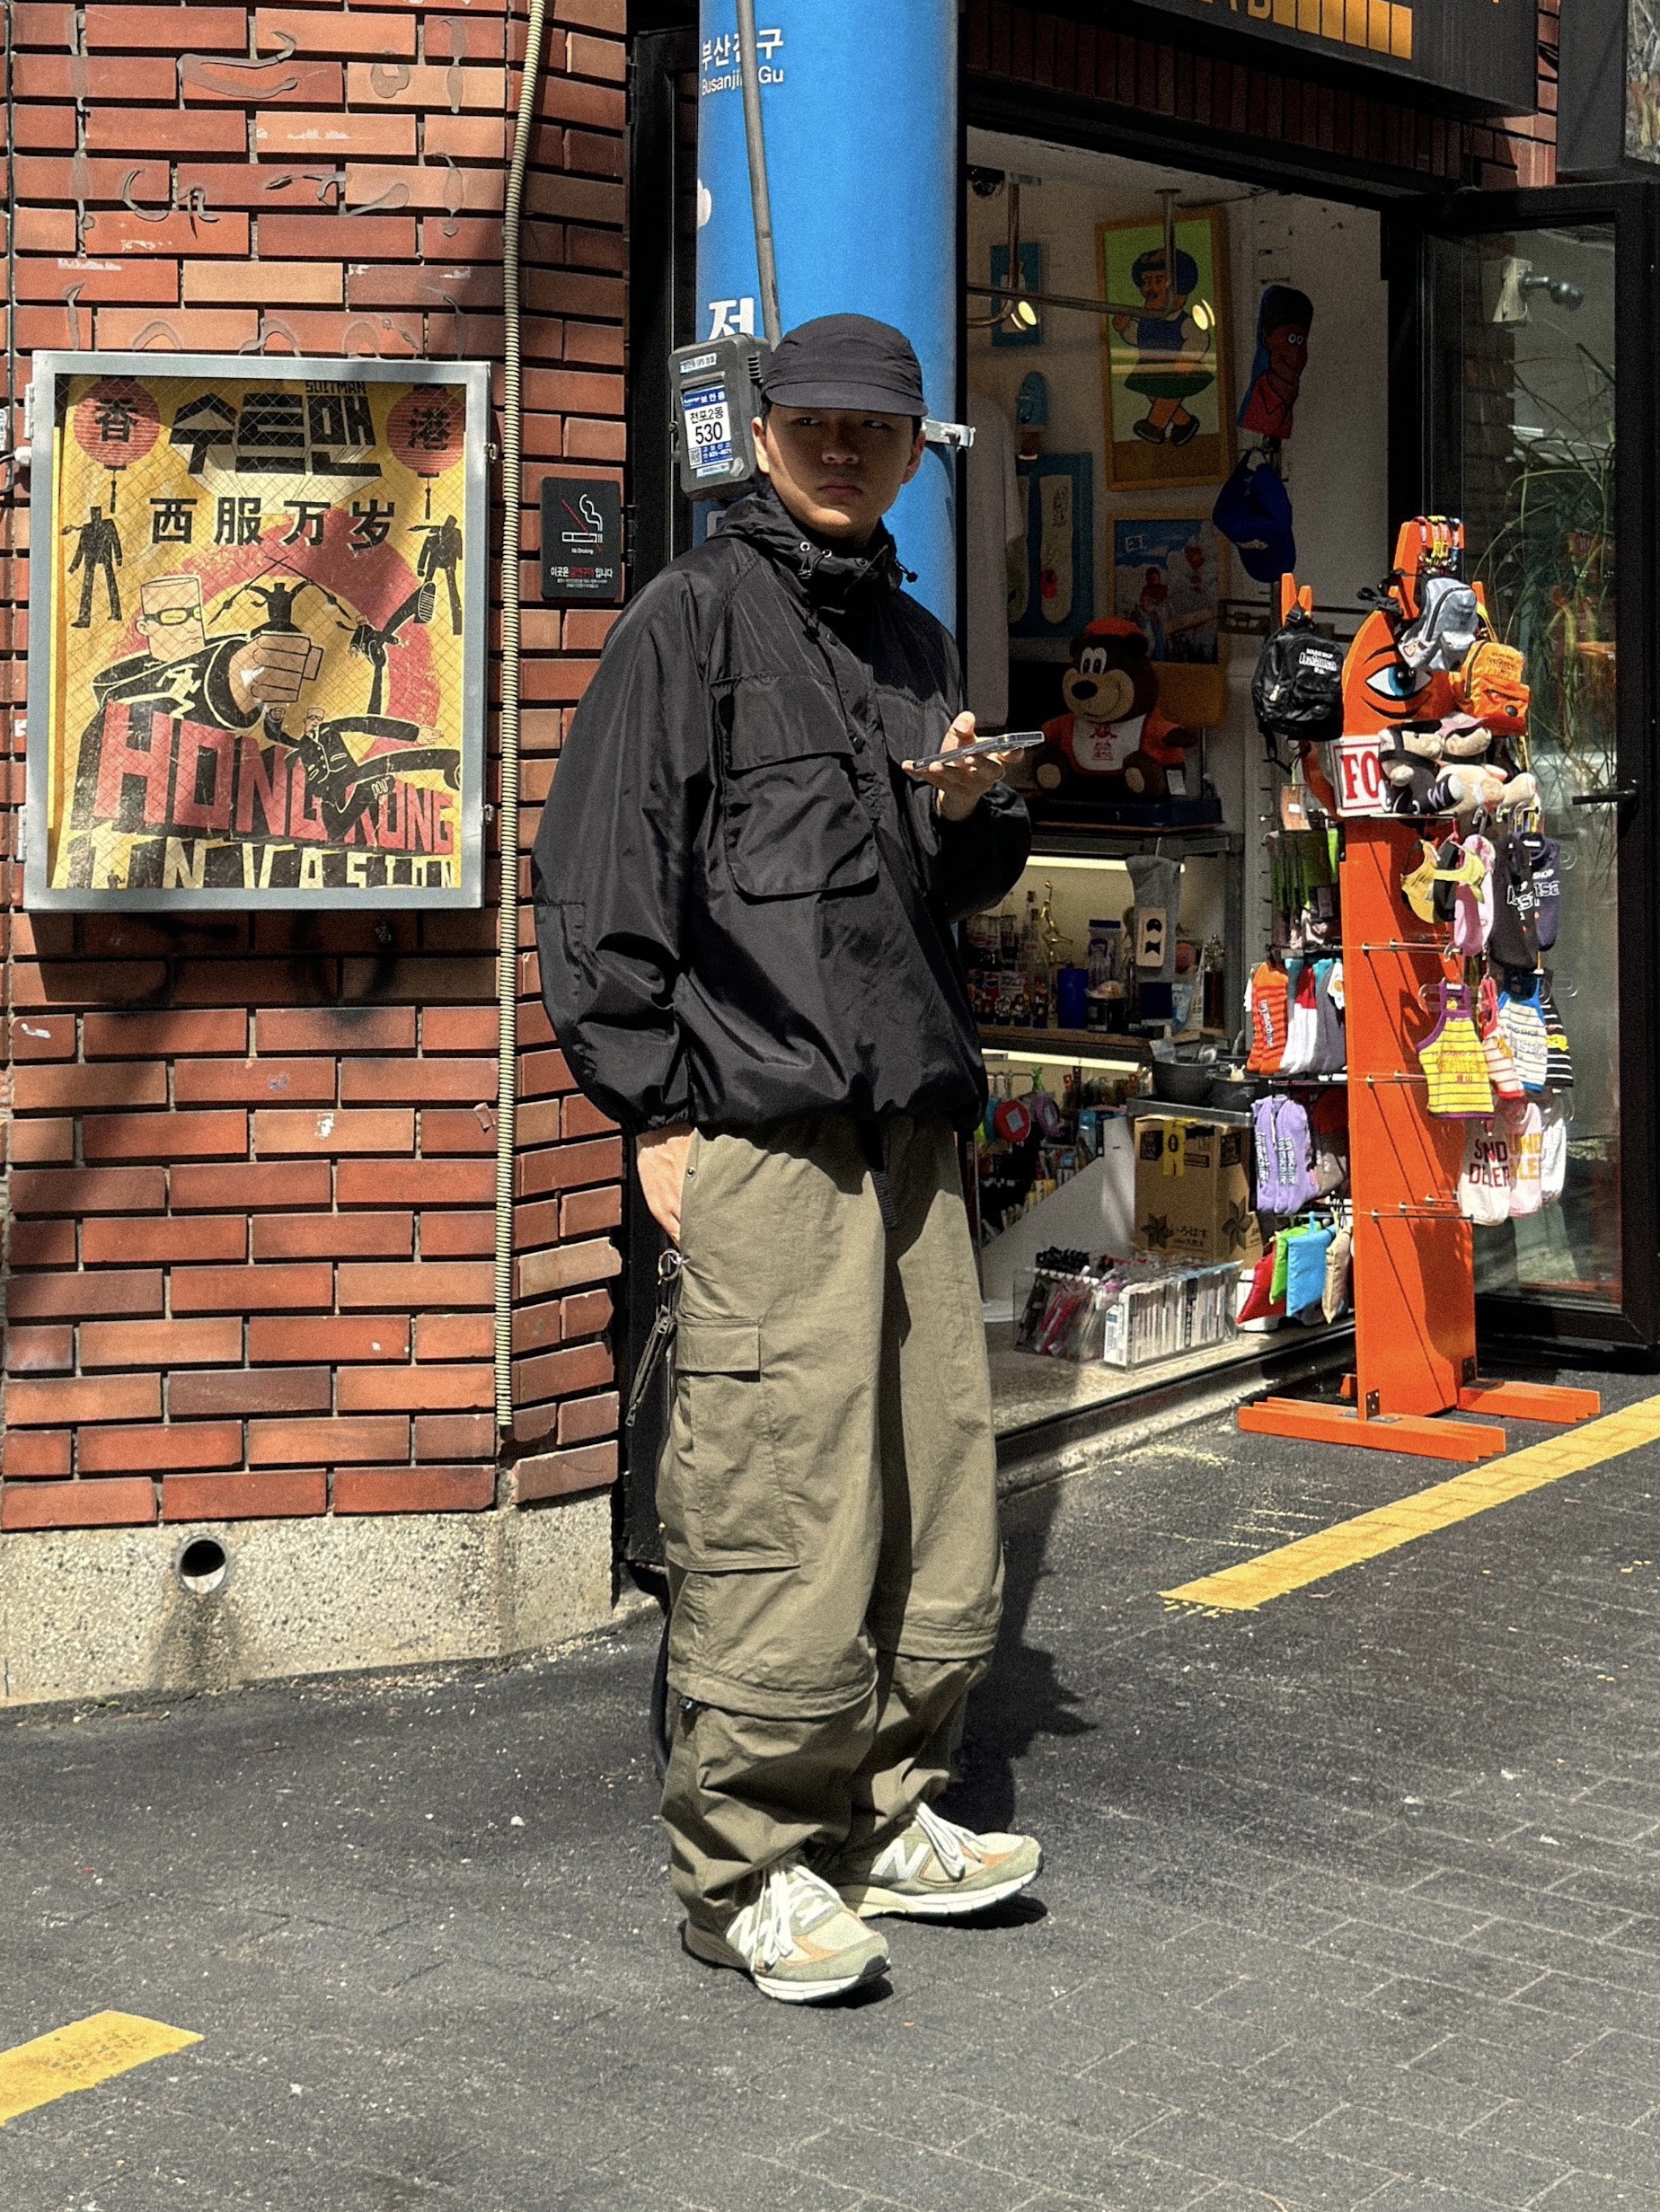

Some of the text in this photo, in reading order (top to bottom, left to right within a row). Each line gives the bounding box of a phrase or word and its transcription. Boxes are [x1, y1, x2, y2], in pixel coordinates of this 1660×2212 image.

[702, 70, 743, 96] Busanji
[305, 381, 366, 393] SUITMAN
[690, 407, 724, 424] 전포2동
[695, 421, 723, 445] 530
[551, 566, 570, 577] 이곳은
[595, 567, 613, 578] 입니다
[93, 700, 331, 842] HONG
